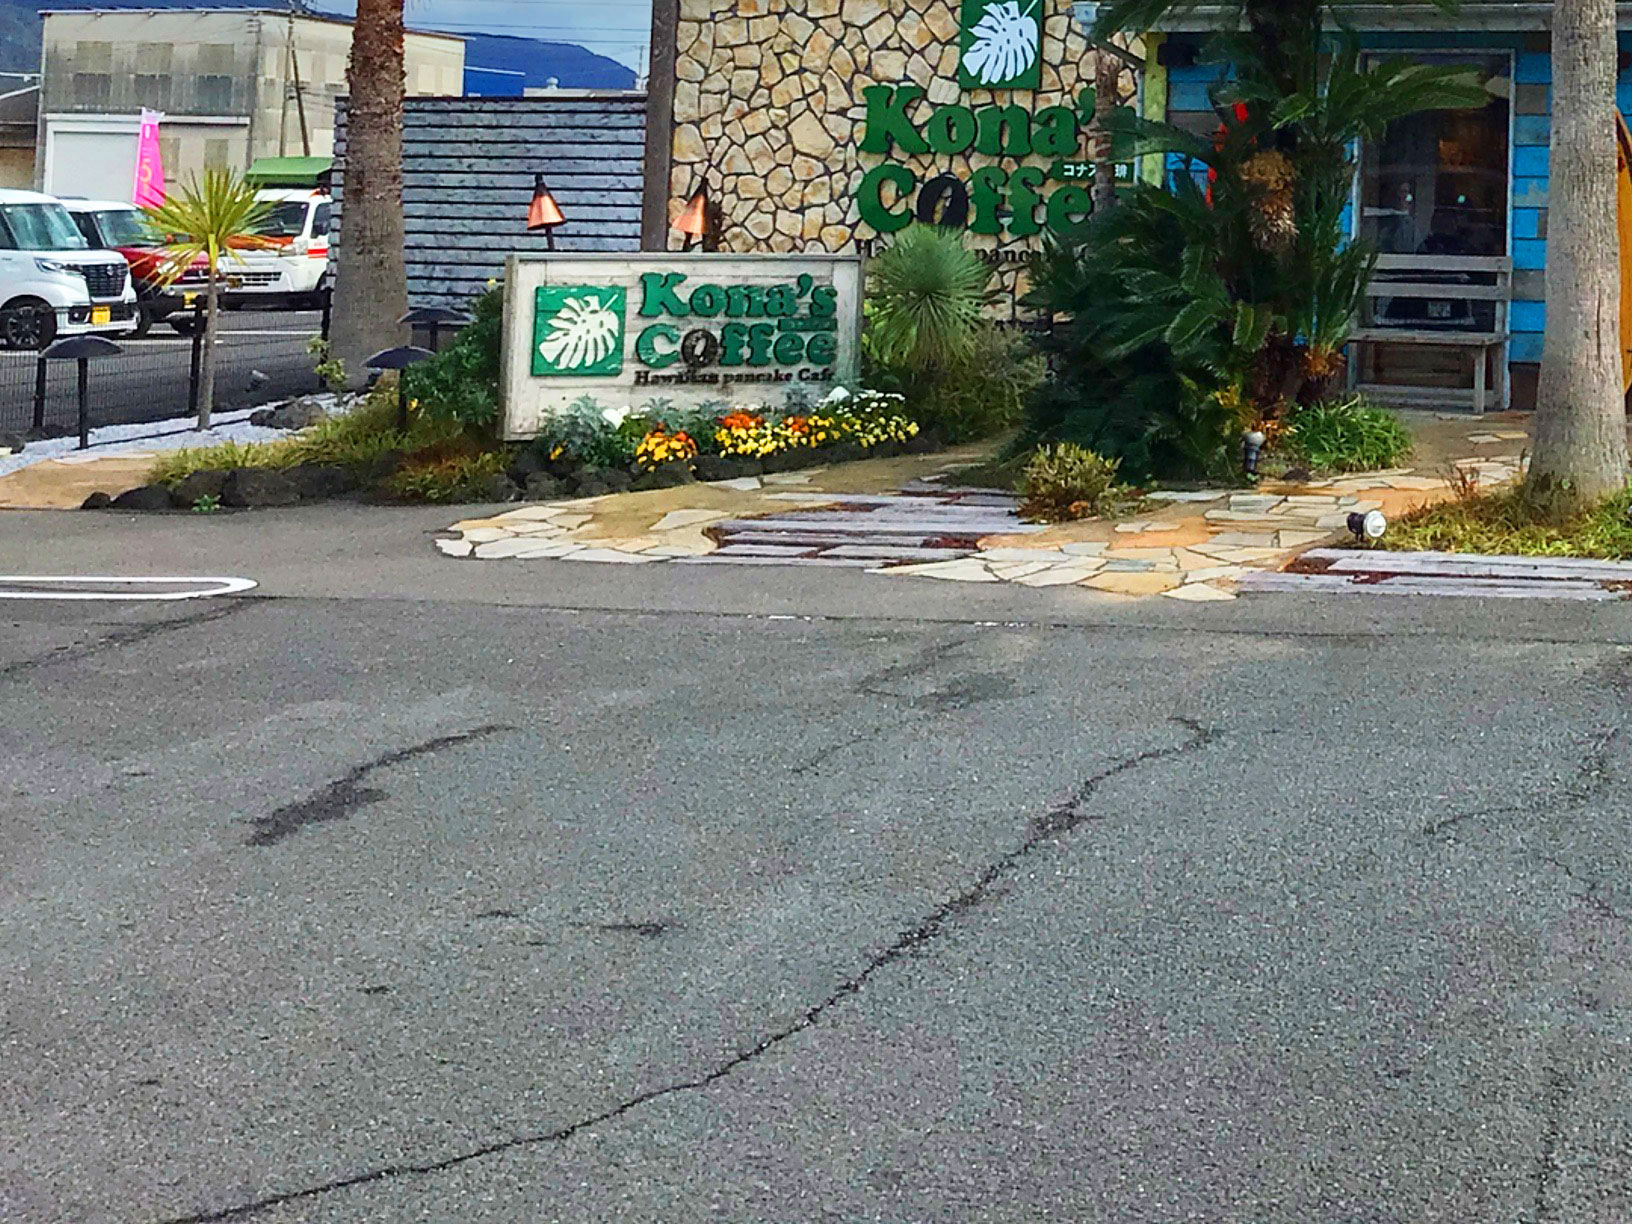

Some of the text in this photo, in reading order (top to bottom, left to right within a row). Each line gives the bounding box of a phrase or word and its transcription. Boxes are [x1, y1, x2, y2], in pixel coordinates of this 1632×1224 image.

[857, 85, 1137, 157] Kona'
[1063, 163, 1128, 178] コナ琲
[857, 163, 1115, 234] Coffe
[638, 271, 837, 317] Kona's
[635, 322, 837, 369] Coffee
[723, 369, 793, 385] pancake
